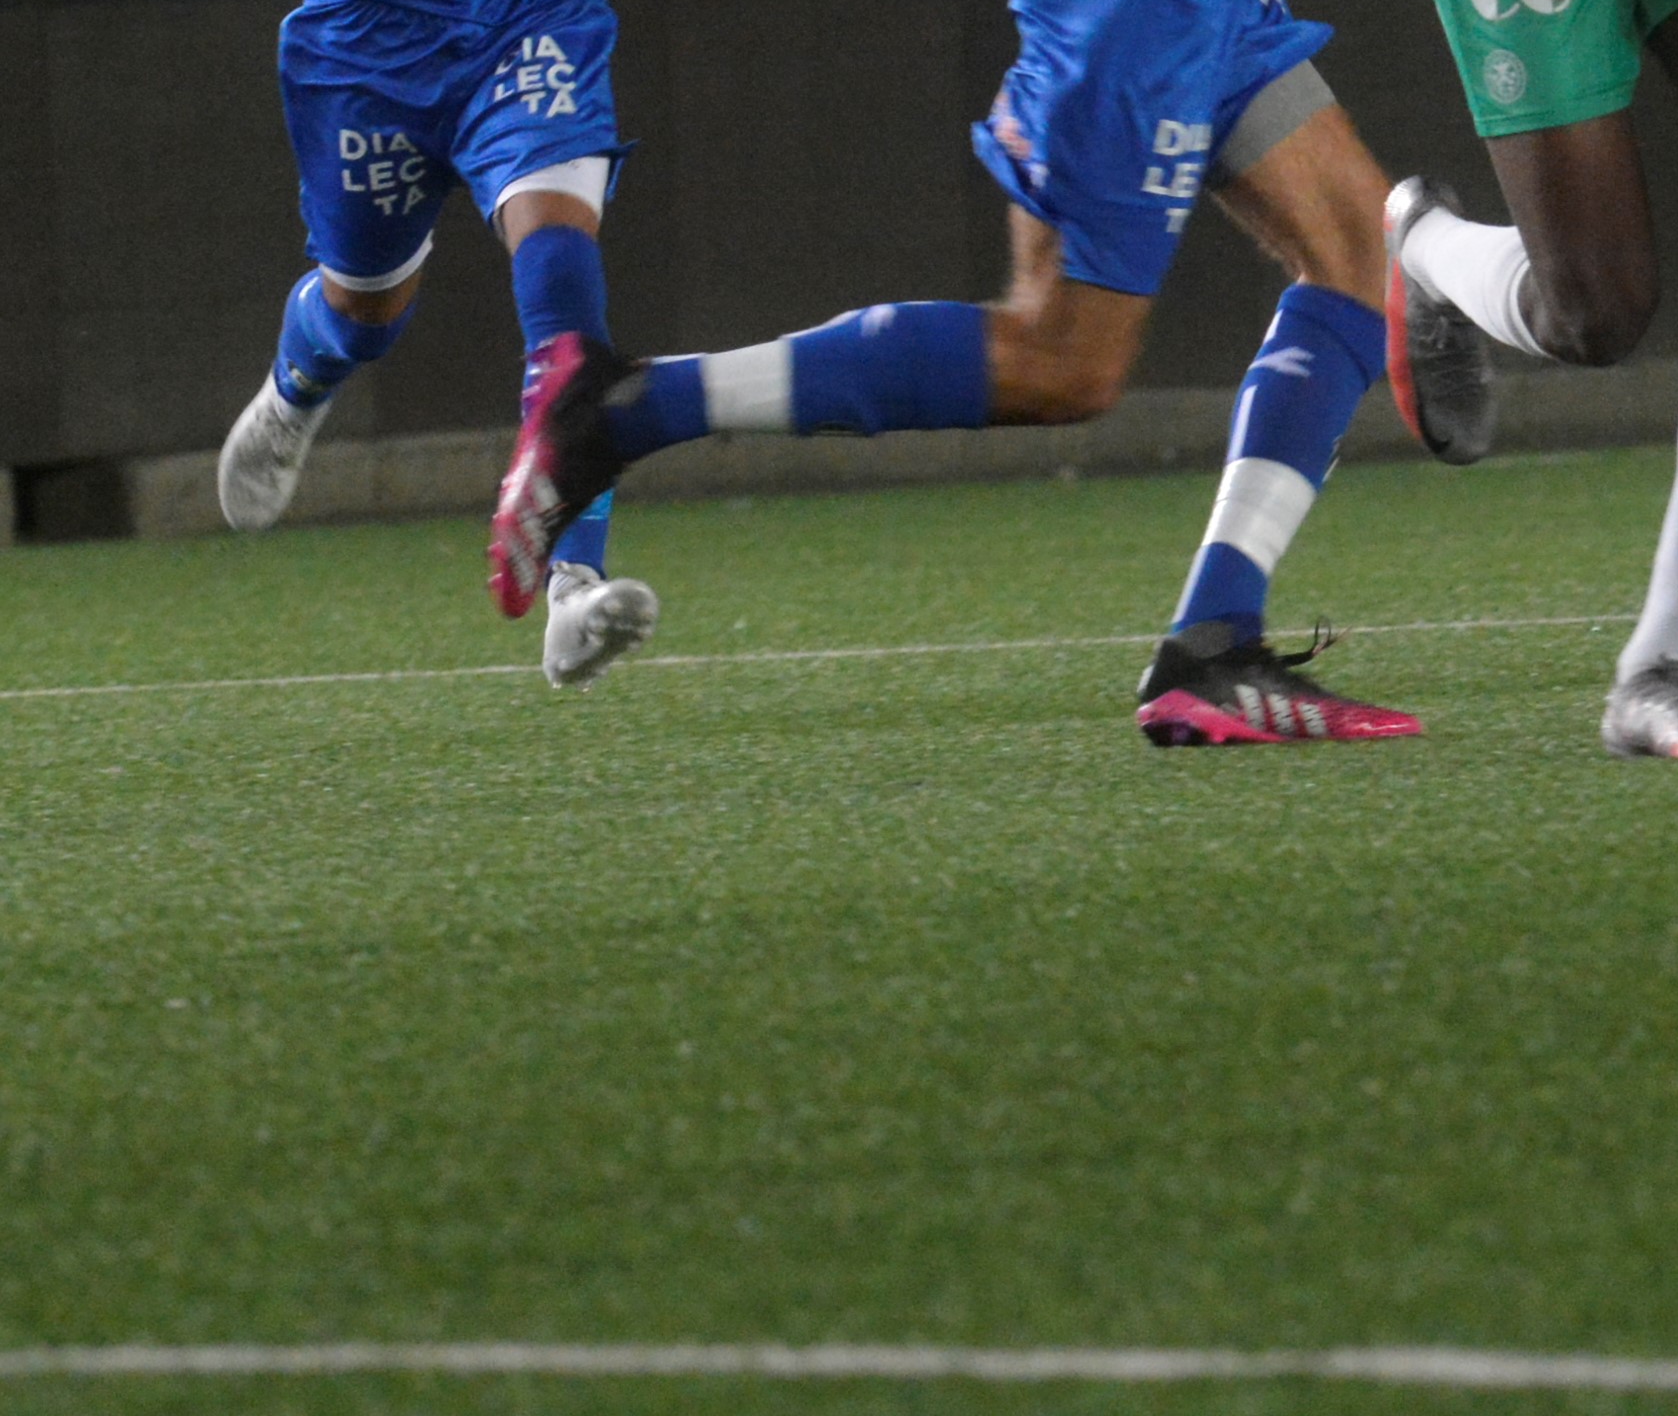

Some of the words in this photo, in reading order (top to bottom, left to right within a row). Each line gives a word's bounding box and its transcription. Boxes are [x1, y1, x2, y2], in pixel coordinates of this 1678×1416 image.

[495, 63, 577, 102] LEC
[520, 90, 578, 118] TA
[339, 129, 418, 160] DIA
[341, 156, 427, 192] LEC
[373, 184, 426, 215] TA
